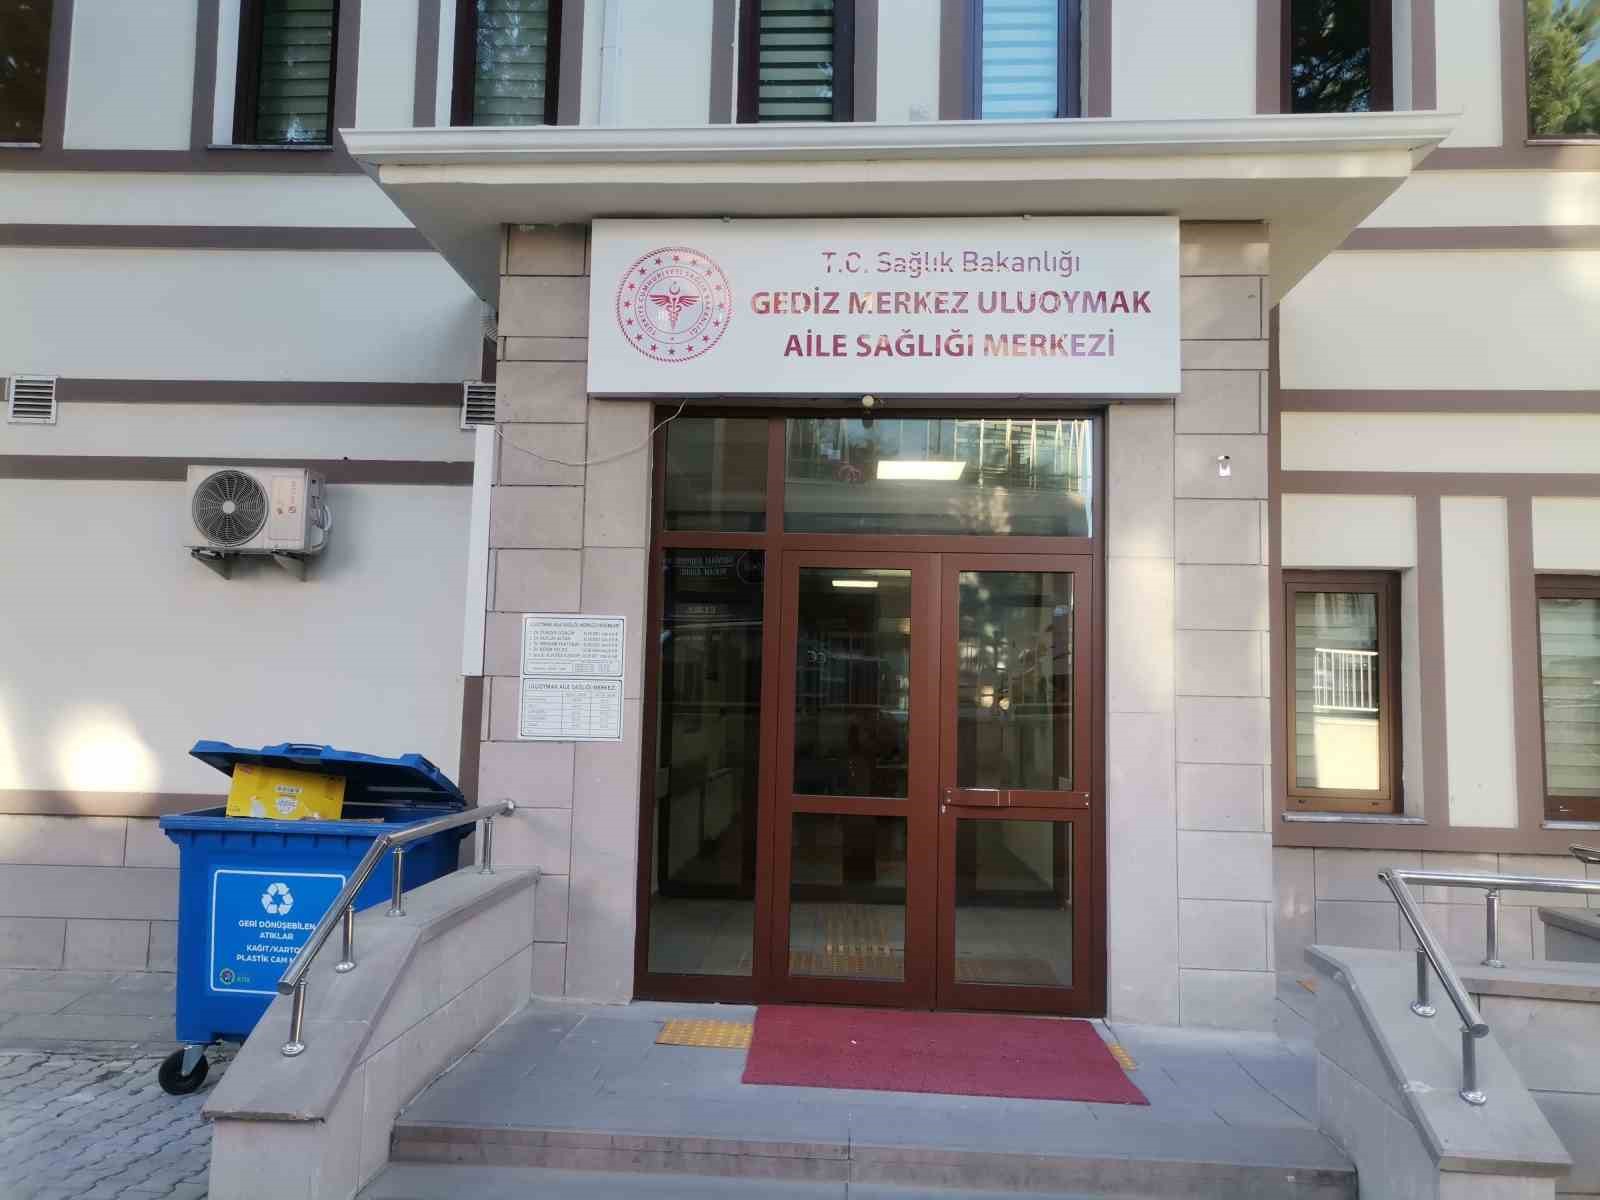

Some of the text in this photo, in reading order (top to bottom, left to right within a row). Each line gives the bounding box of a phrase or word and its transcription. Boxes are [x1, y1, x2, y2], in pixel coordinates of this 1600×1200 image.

[822, 250, 1080, 278] T.C. Sağlık Bakanlığı
[751, 286, 1151, 315] GEDİZ MERKEZ ULUOYMAK
[784, 328, 1115, 357] AİLE SAĞLIĞI MERKEZİ
[239, 919, 257, 928] GERİ
[259, 932, 293, 940] ATIKLAR
[246, 944, 300, 954] KAĞIT/KARTO
[236, 953, 269, 962] PLASTİK
